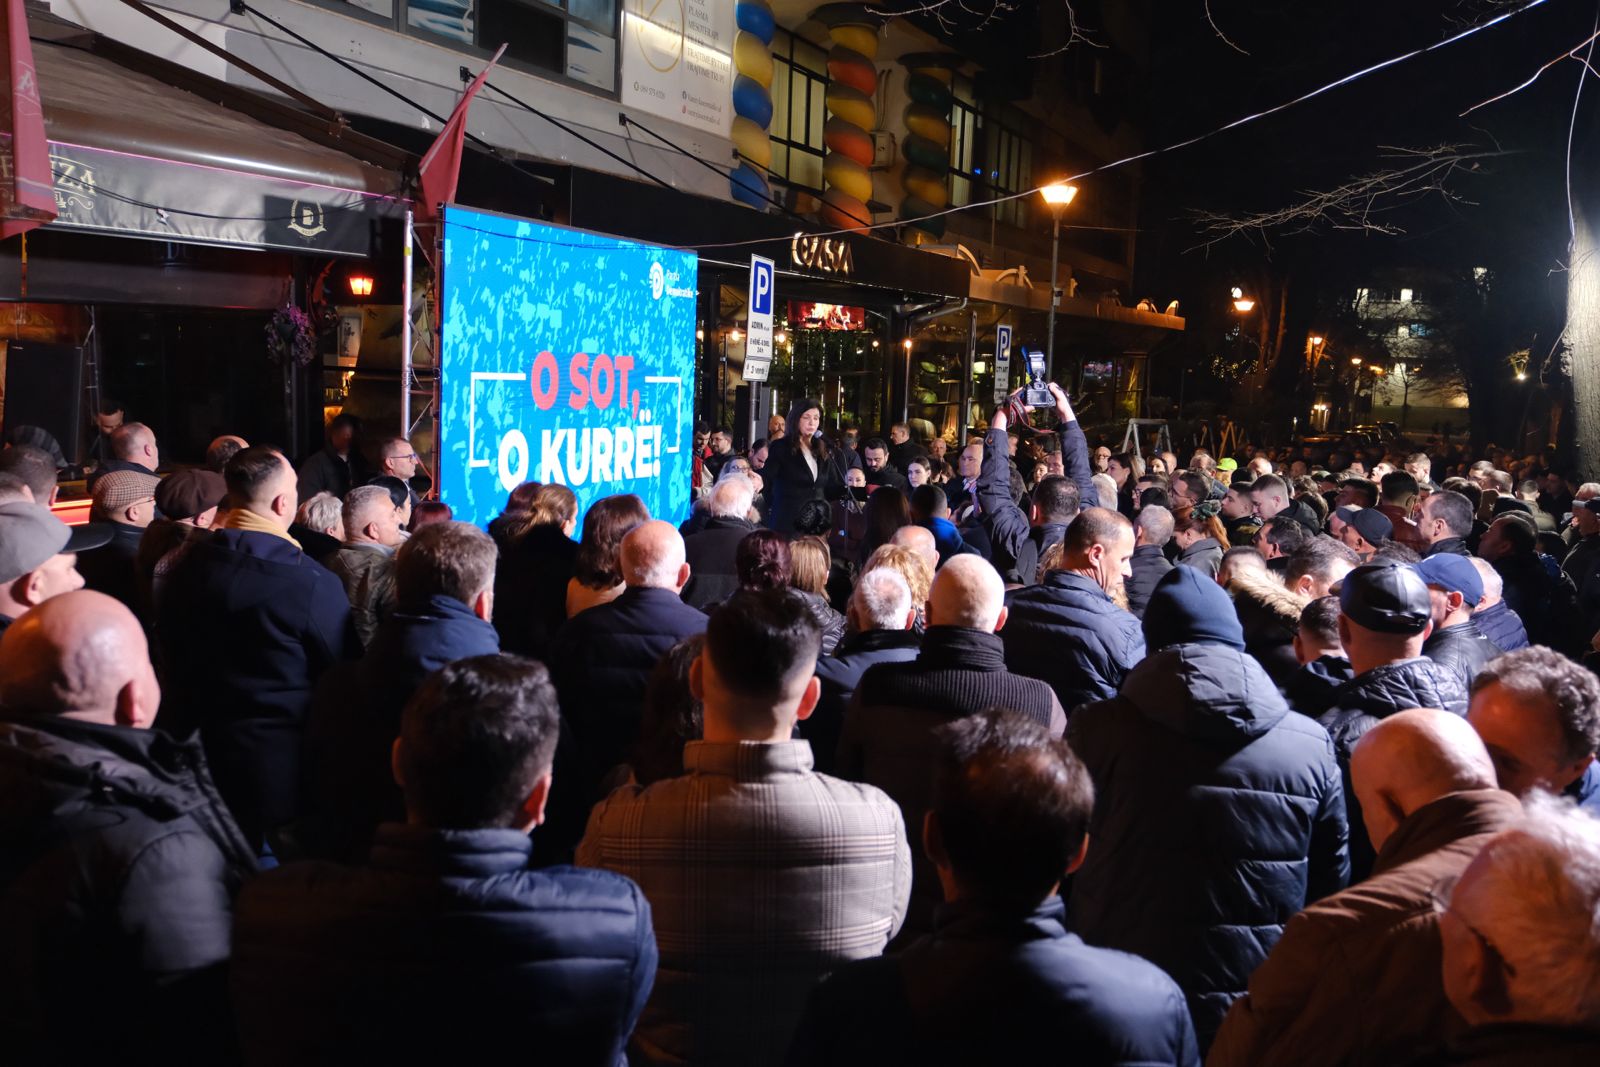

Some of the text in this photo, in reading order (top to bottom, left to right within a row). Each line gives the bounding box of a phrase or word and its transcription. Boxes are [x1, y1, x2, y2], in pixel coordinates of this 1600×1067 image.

[755, 265, 770, 309] P
[1000, 330, 1008, 358] P
[531, 351, 640, 420] O SOT,
[498, 409, 662, 493] O KURRË!
